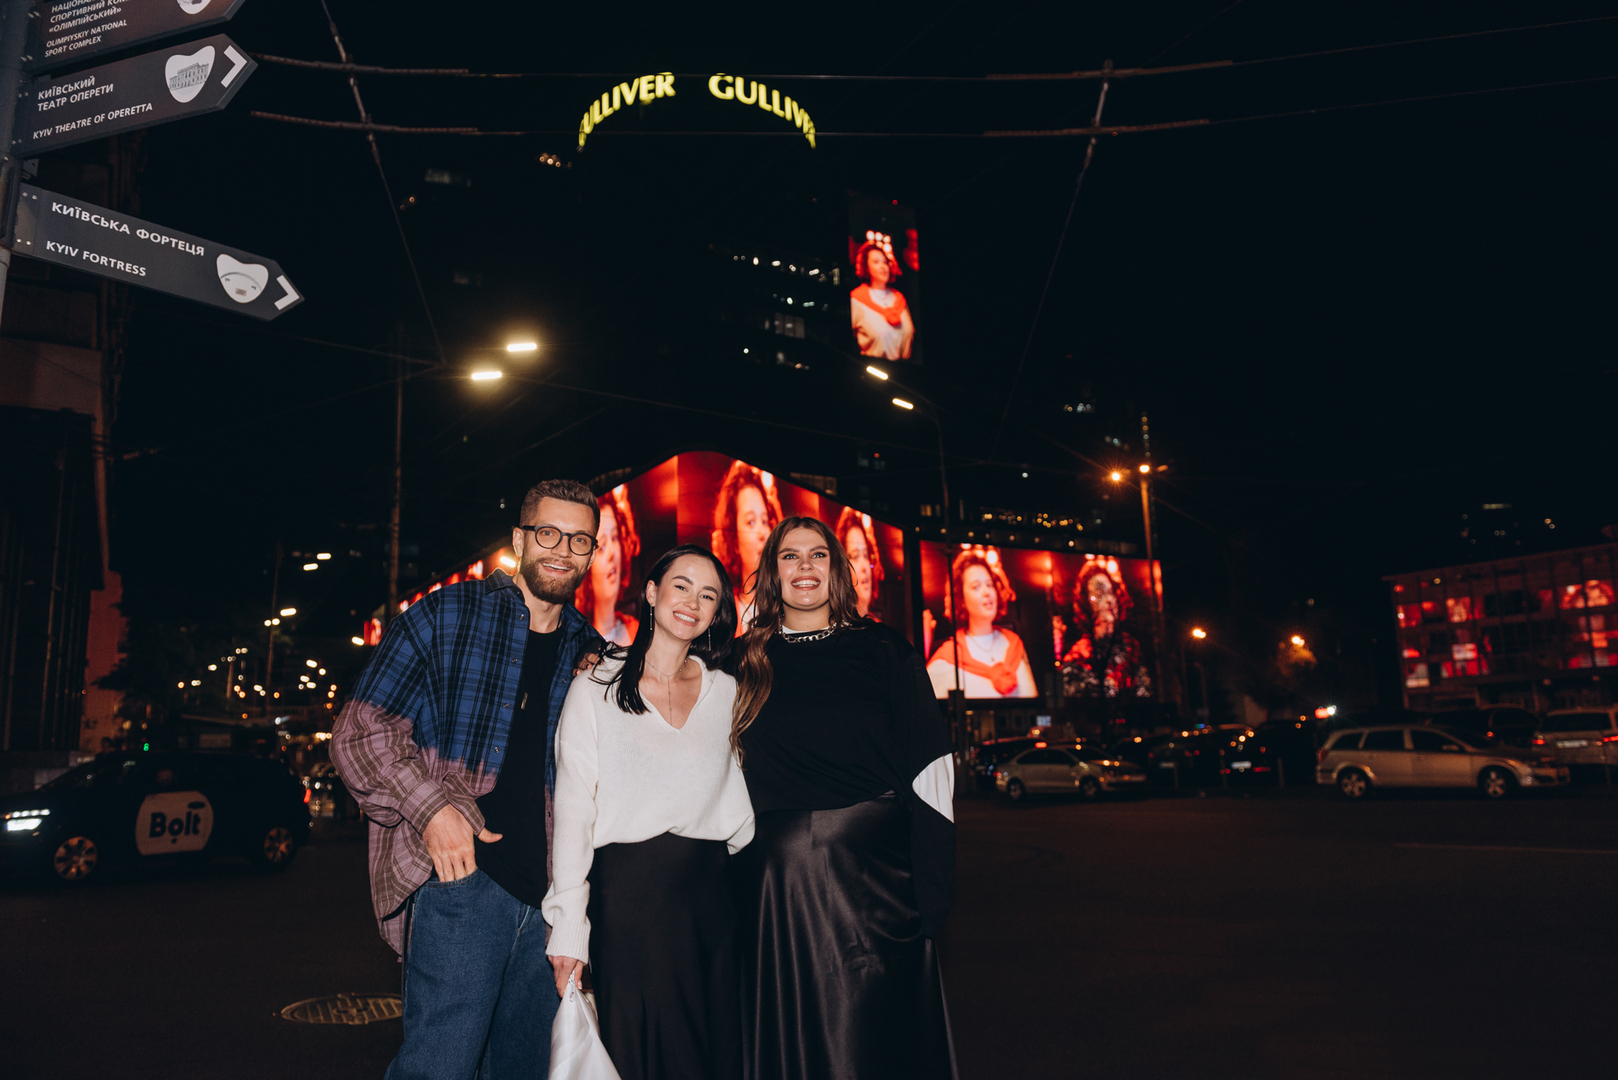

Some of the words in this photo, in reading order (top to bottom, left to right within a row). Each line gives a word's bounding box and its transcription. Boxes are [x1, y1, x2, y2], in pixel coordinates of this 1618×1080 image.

[50, 1, 106, 23] СПОРТИВНИЙ
[44, 45, 68, 58] SPORT
[68, 35, 102, 51] COMPLEX
[46, 29, 90, 48] OLIMPIYSKIY
[90, 19, 128, 35] NATIONAL
[37, 75, 96, 100] КИЇВСЬКИЙ
[37, 97, 67, 112] ТЕАТР
[69, 83, 114, 103] ОПЕРЕТИ
[32, 127, 53, 140] KYIV
[54, 117, 92, 134] THEATRE
[93, 113, 106, 124] OF
[107, 102, 153, 120] OPERETTA
[708, 72, 816, 149] GULLIV
[51, 201, 131, 235] КИЇВСЬКА
[136, 228, 205, 257] ФОРТЕЦЯ
[46, 240, 79, 258] KYIV
[82, 250, 147, 277] FORTRESS
[150, 811, 201, 844] Bolt
